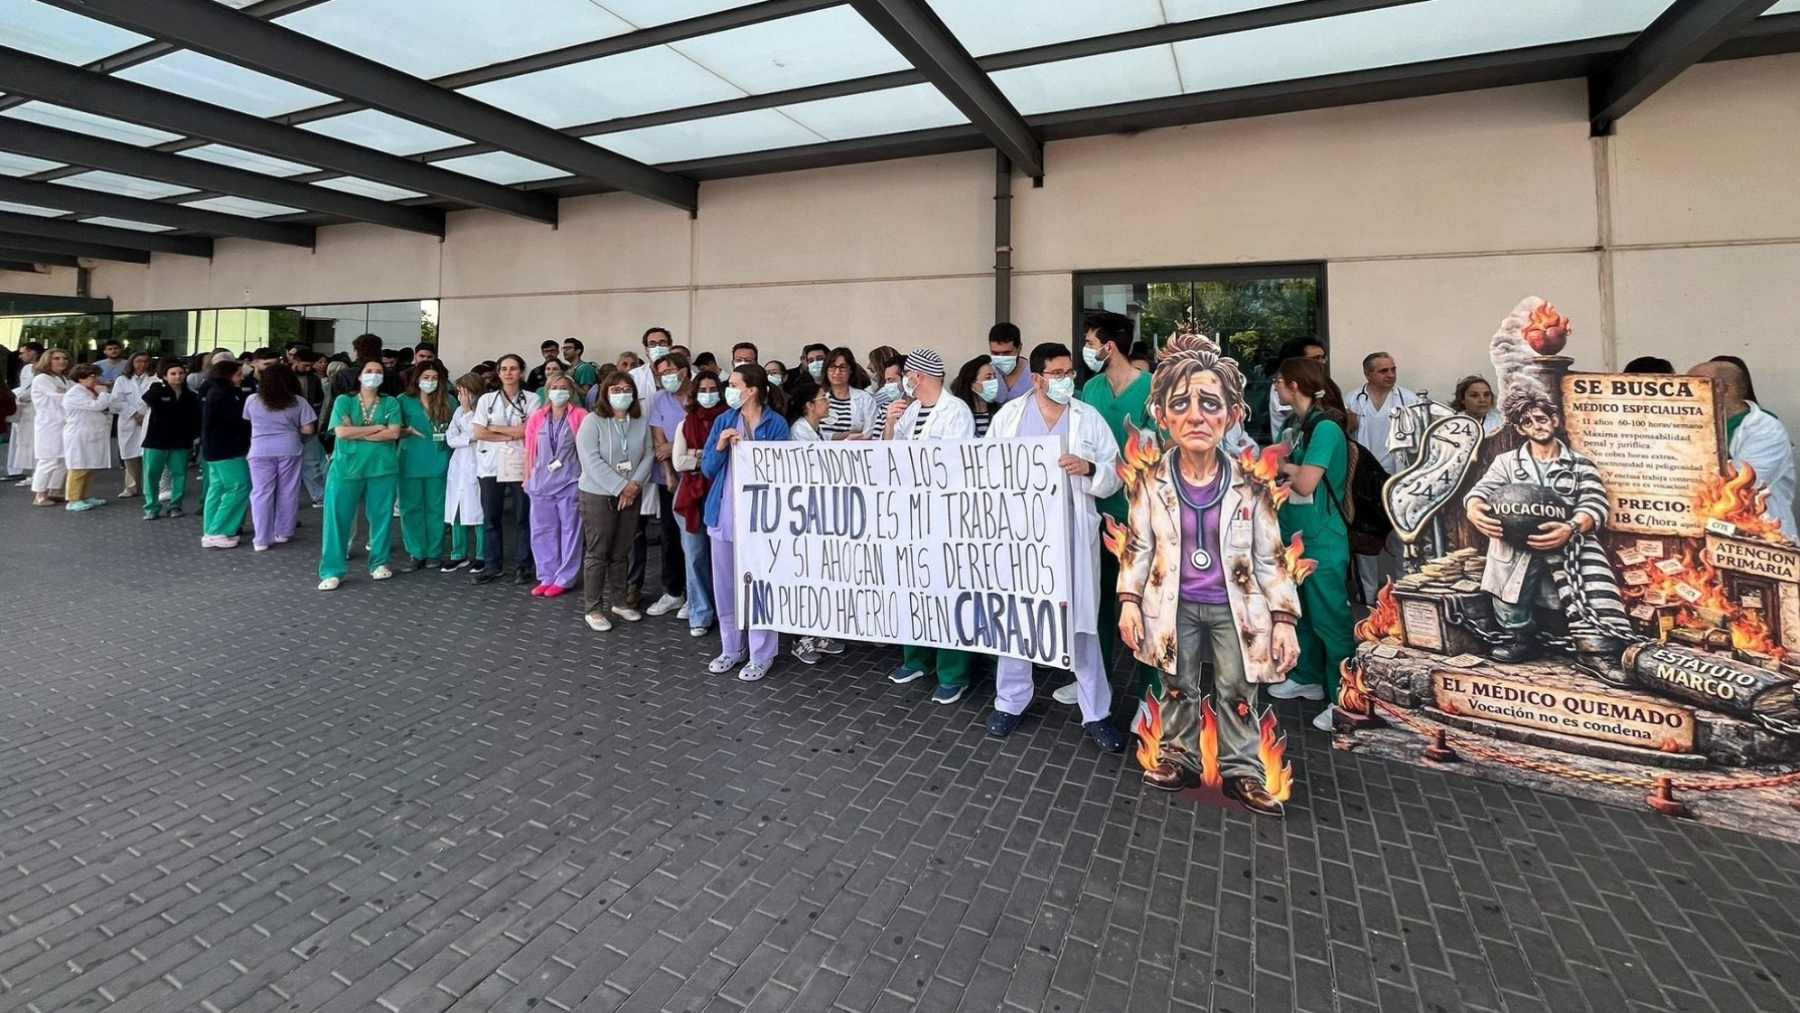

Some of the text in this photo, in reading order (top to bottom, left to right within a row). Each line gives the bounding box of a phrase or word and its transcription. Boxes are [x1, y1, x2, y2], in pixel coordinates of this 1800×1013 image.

[1574, 380, 1693, 397] SE BUSCA
[1450, 422, 1472, 436] 24
[1623, 404, 1703, 416] ESPECIALISTA
[752, 443, 1057, 496] REMITIÉNDOME A LOS HECHOS,
[742, 484, 1046, 542] TU SALUD, ES MI TRABAJO
[1615, 513, 1631, 524] 18
[1635, 514, 1677, 527] €/hora
[1617, 498, 1690, 513] PRECIO:
[768, 535, 1055, 595] Y SI AHOGAN MIS DERECHOS
[1717, 554, 1792, 577] PRIMARIA
[779, 585, 831, 631] PUEDO
[836, 588, 899, 639] HACERLO
[909, 591, 959, 647] BIEN,
[954, 591, 1071, 667] CARAJO!
[1653, 648, 1755, 687] ESTATUTO
[1656, 663, 1734, 700] MARCO
[1442, 677, 1683, 729] EL MÉDICO QUEMADO
[1468, 699, 1651, 739] Vocación no es condena
